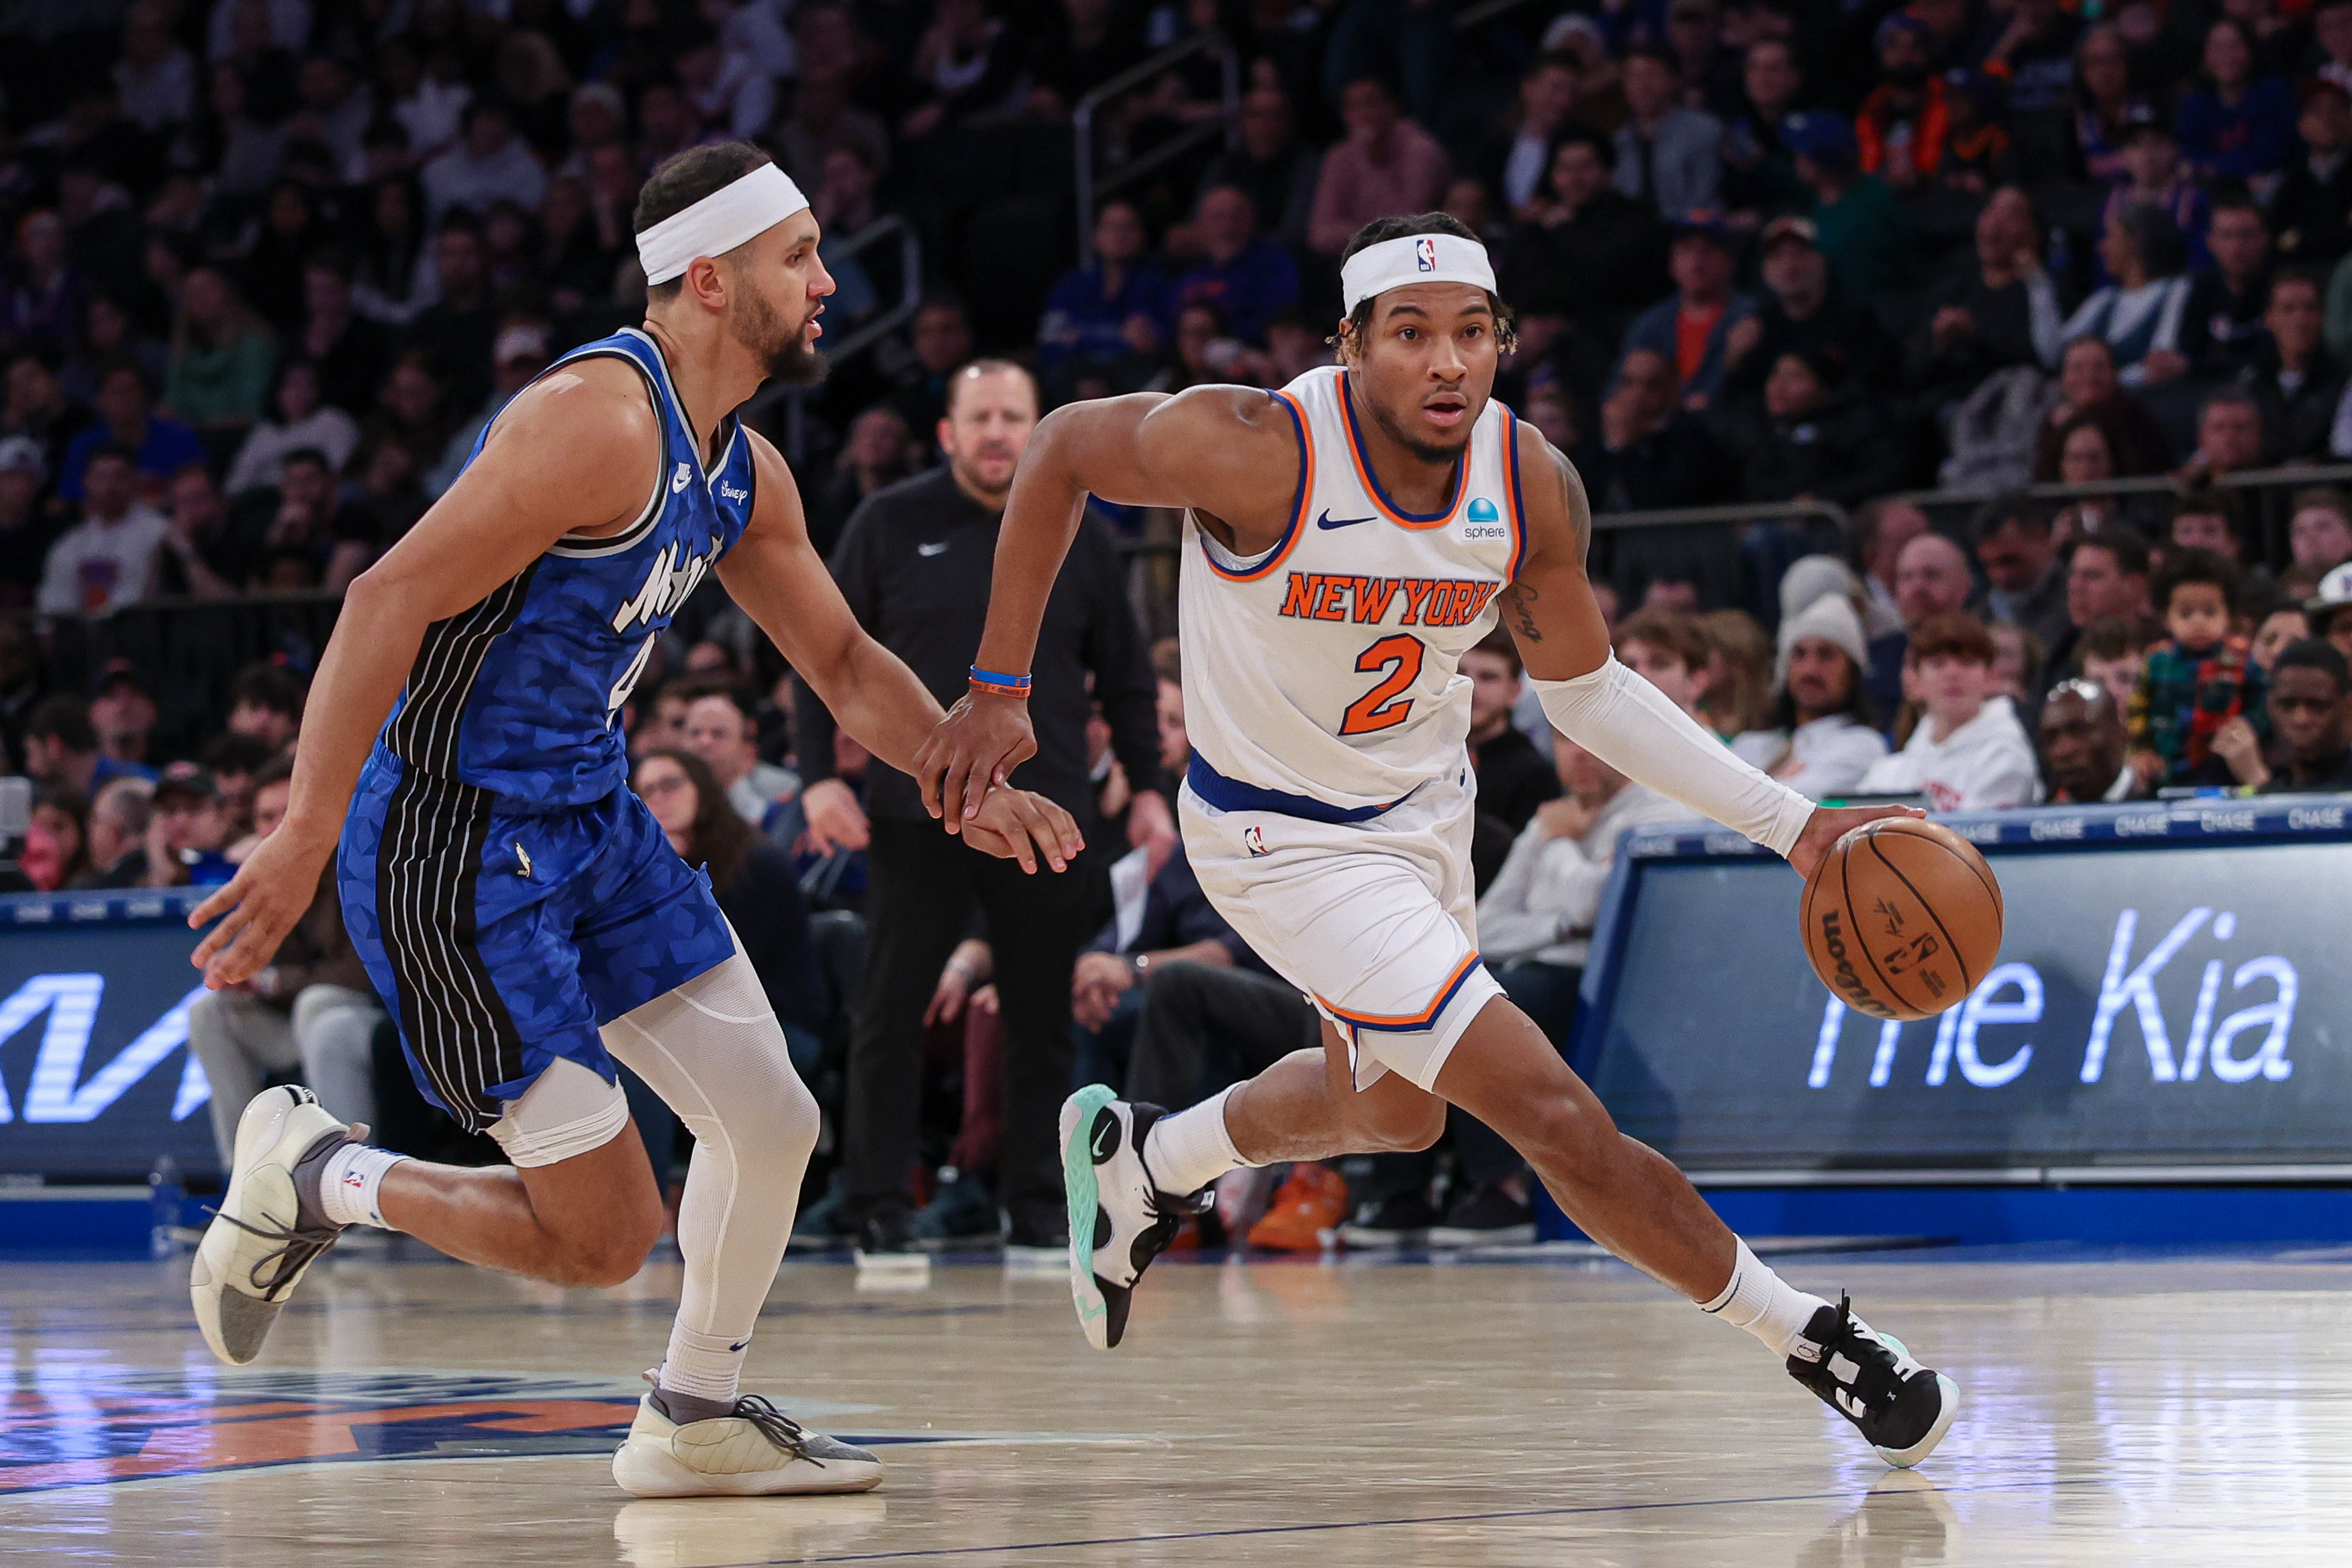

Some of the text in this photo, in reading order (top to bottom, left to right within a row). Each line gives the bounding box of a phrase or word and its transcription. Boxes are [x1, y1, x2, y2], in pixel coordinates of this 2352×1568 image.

[721, 479, 748, 506] Disney
[1465, 526, 1505, 539] sphere
[1278, 571, 1400, 625] NEW
[1398, 576, 1502, 628] YORK
[1338, 632, 1426, 736] 2
[2079, 906, 2300, 1083] Kia
